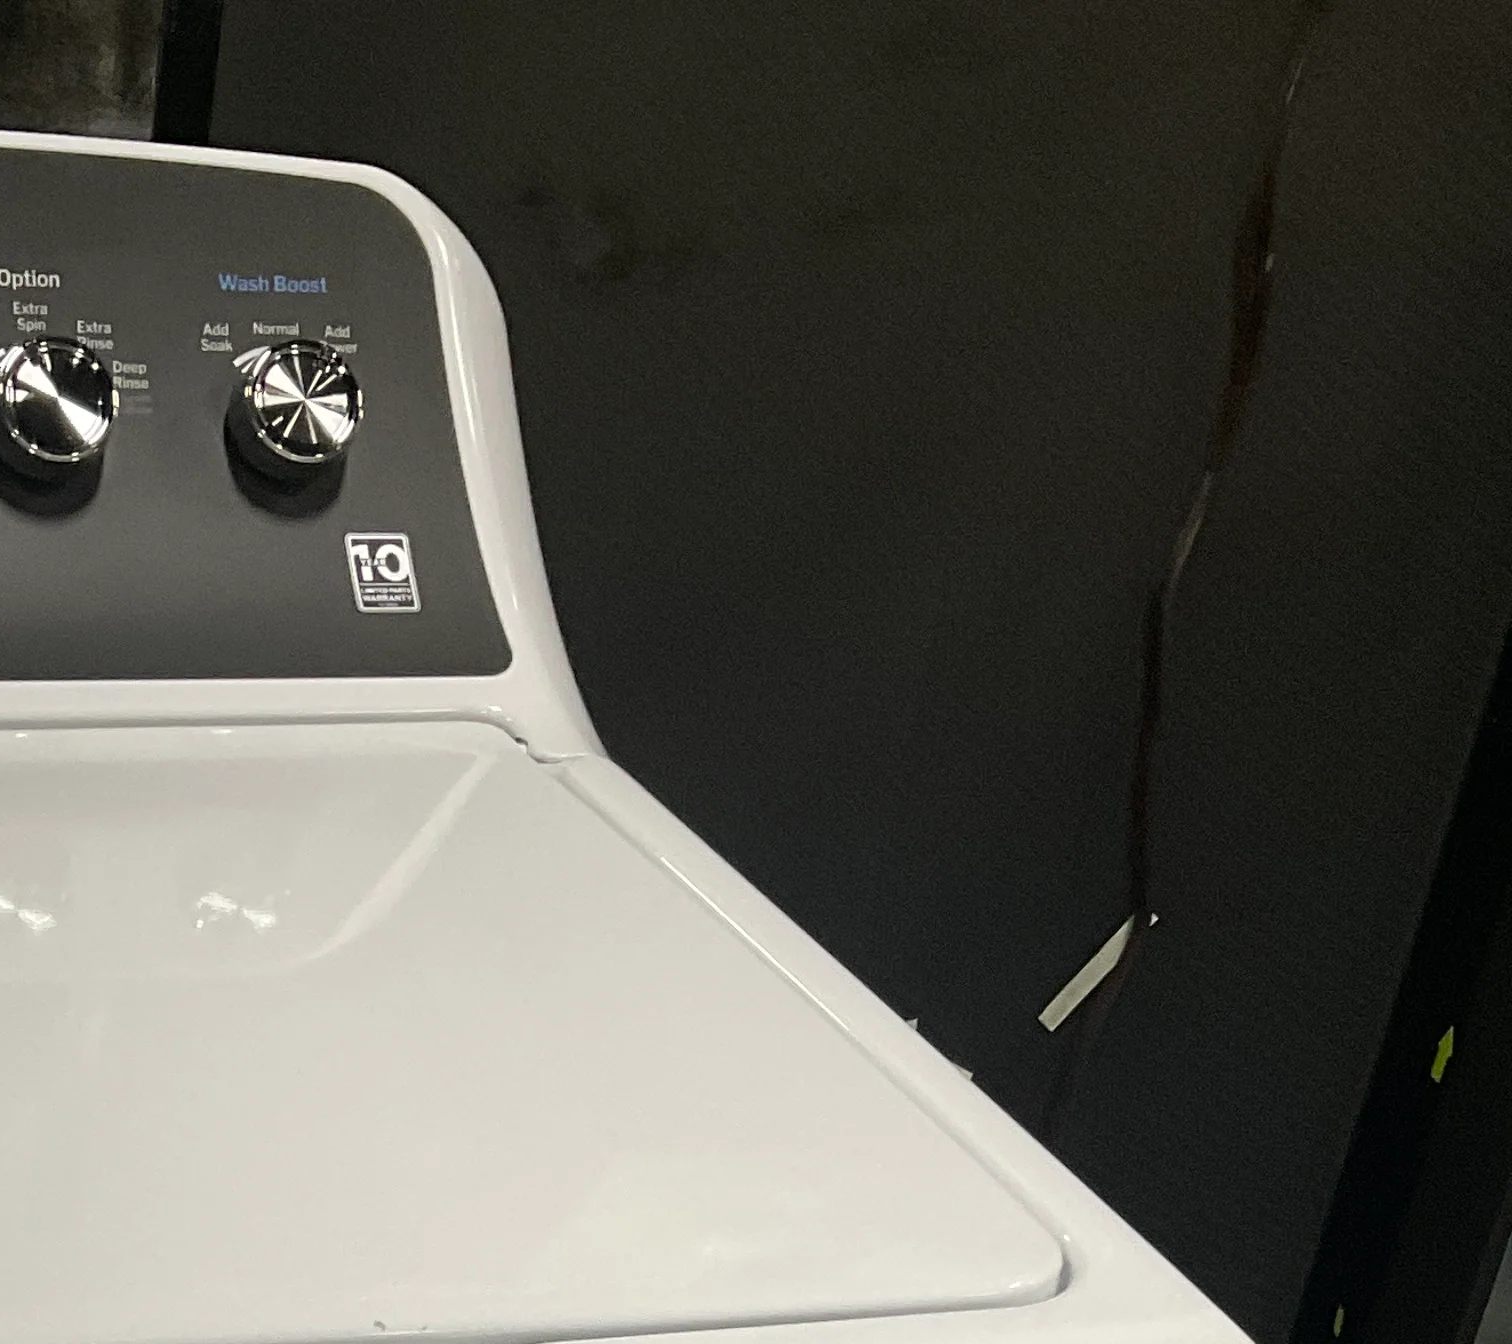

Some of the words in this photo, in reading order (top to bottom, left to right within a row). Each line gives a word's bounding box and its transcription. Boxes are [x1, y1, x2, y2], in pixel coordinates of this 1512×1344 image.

[218, 273, 270, 292] Wash
[273, 274, 328, 293] Boost
[13, 301, 49, 316] Extra
[17, 317, 47, 333] Spin
[76, 319, 113, 335] Extra
[202, 322, 230, 337] Add
[252, 321, 300, 336] Normal
[324, 324, 351, 338] Add
[200, 338, 234, 352] Soak
[112, 360, 148, 375] Deep
[112, 376, 150, 390] Rinse
[351, 544, 410, 582] 10
